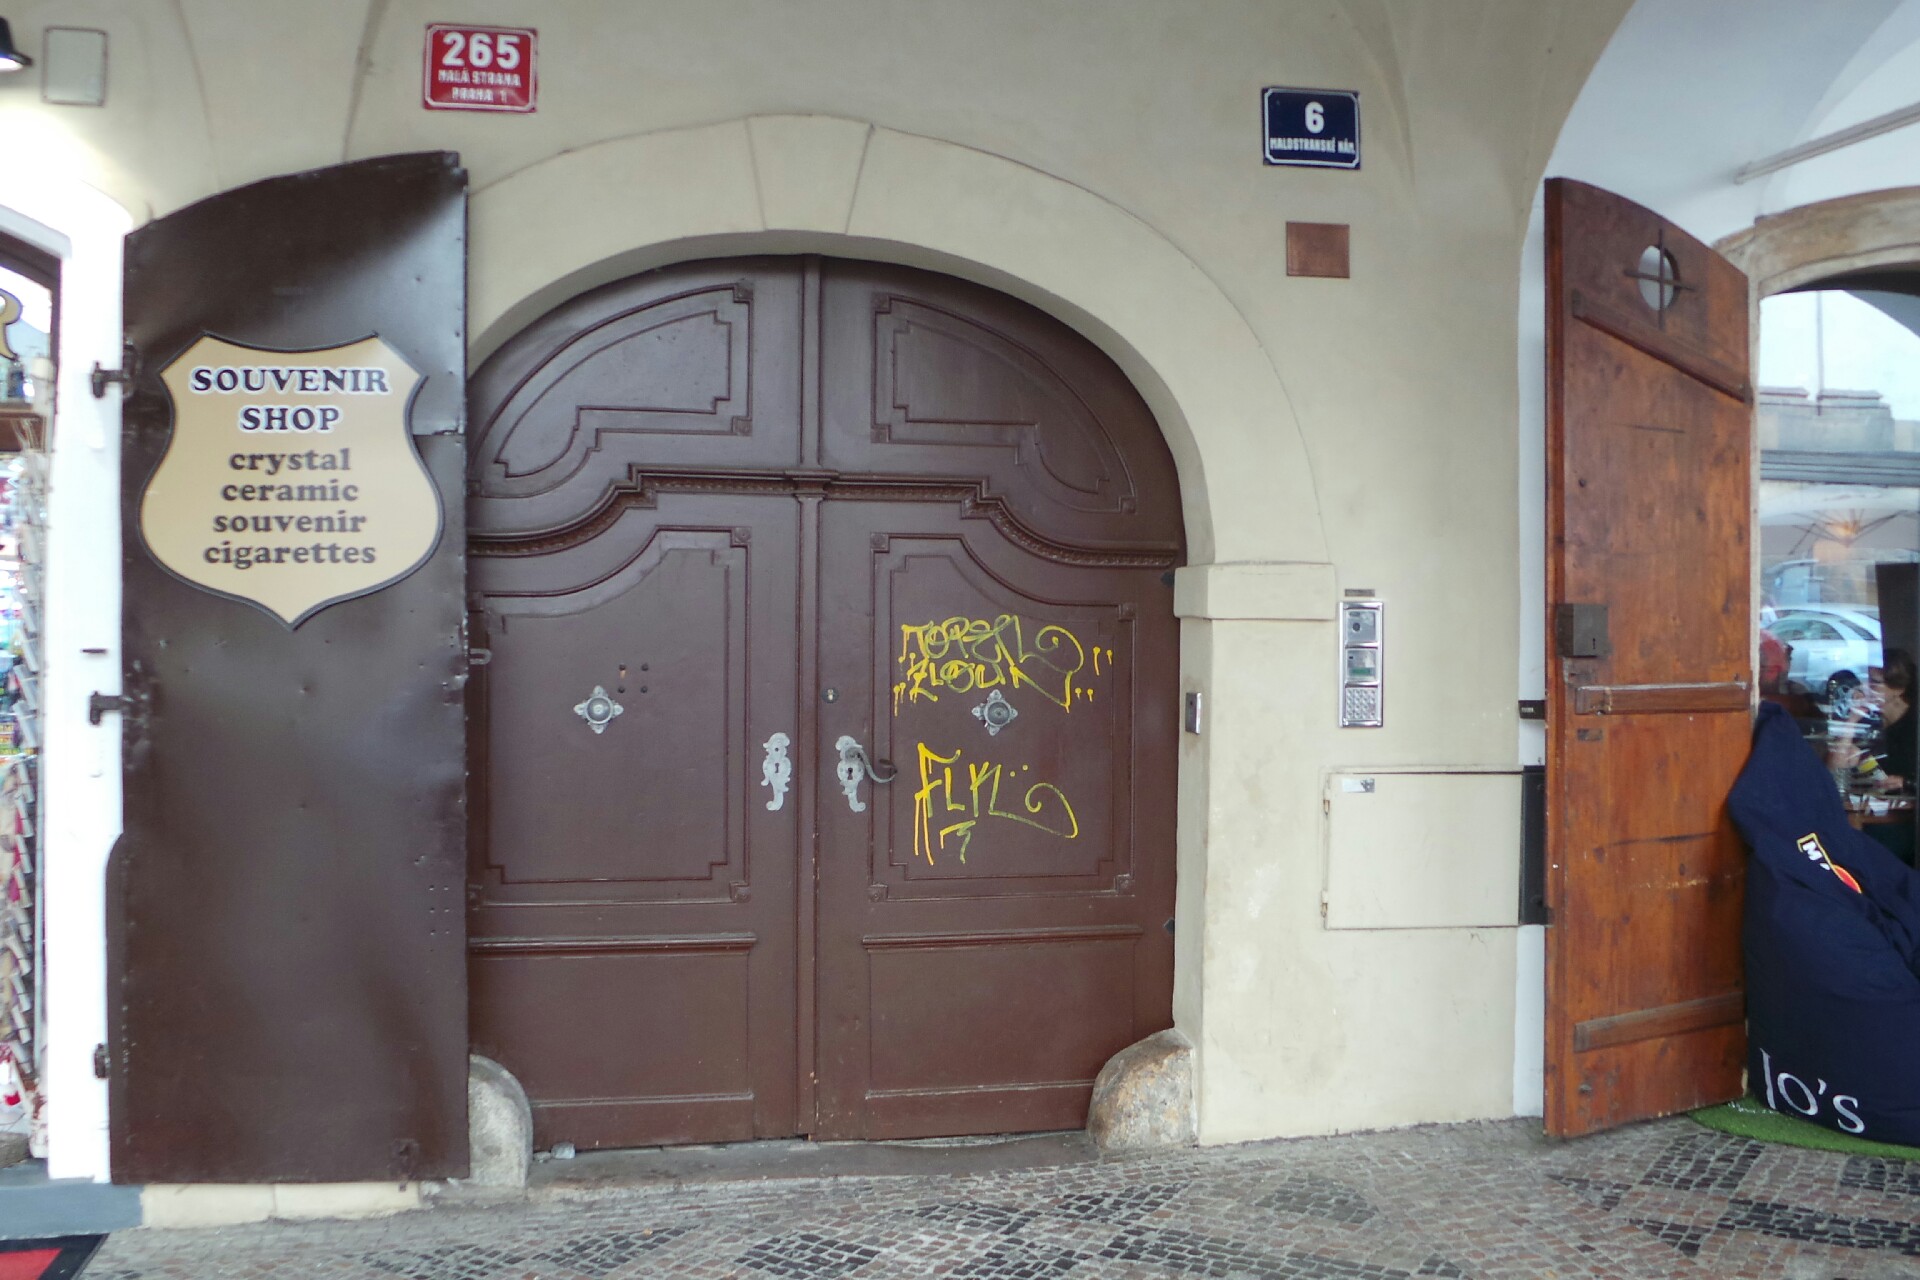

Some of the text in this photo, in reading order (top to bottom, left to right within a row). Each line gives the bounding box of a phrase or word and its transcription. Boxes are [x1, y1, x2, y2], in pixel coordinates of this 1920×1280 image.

[442, 32, 521, 70] 265
[438, 68, 521, 87] MALÁ STRANA
[452, 87, 494, 102] PRAHA
[1305, 101, 1325, 134] 6
[192, 368, 389, 393] SOUVENIR
[241, 406, 341, 432] SHOP
[229, 448, 353, 475] crystal
[221, 479, 360, 502] ceramic
[212, 510, 368, 533] souvenir
[203, 541, 377, 570] cigarettes
